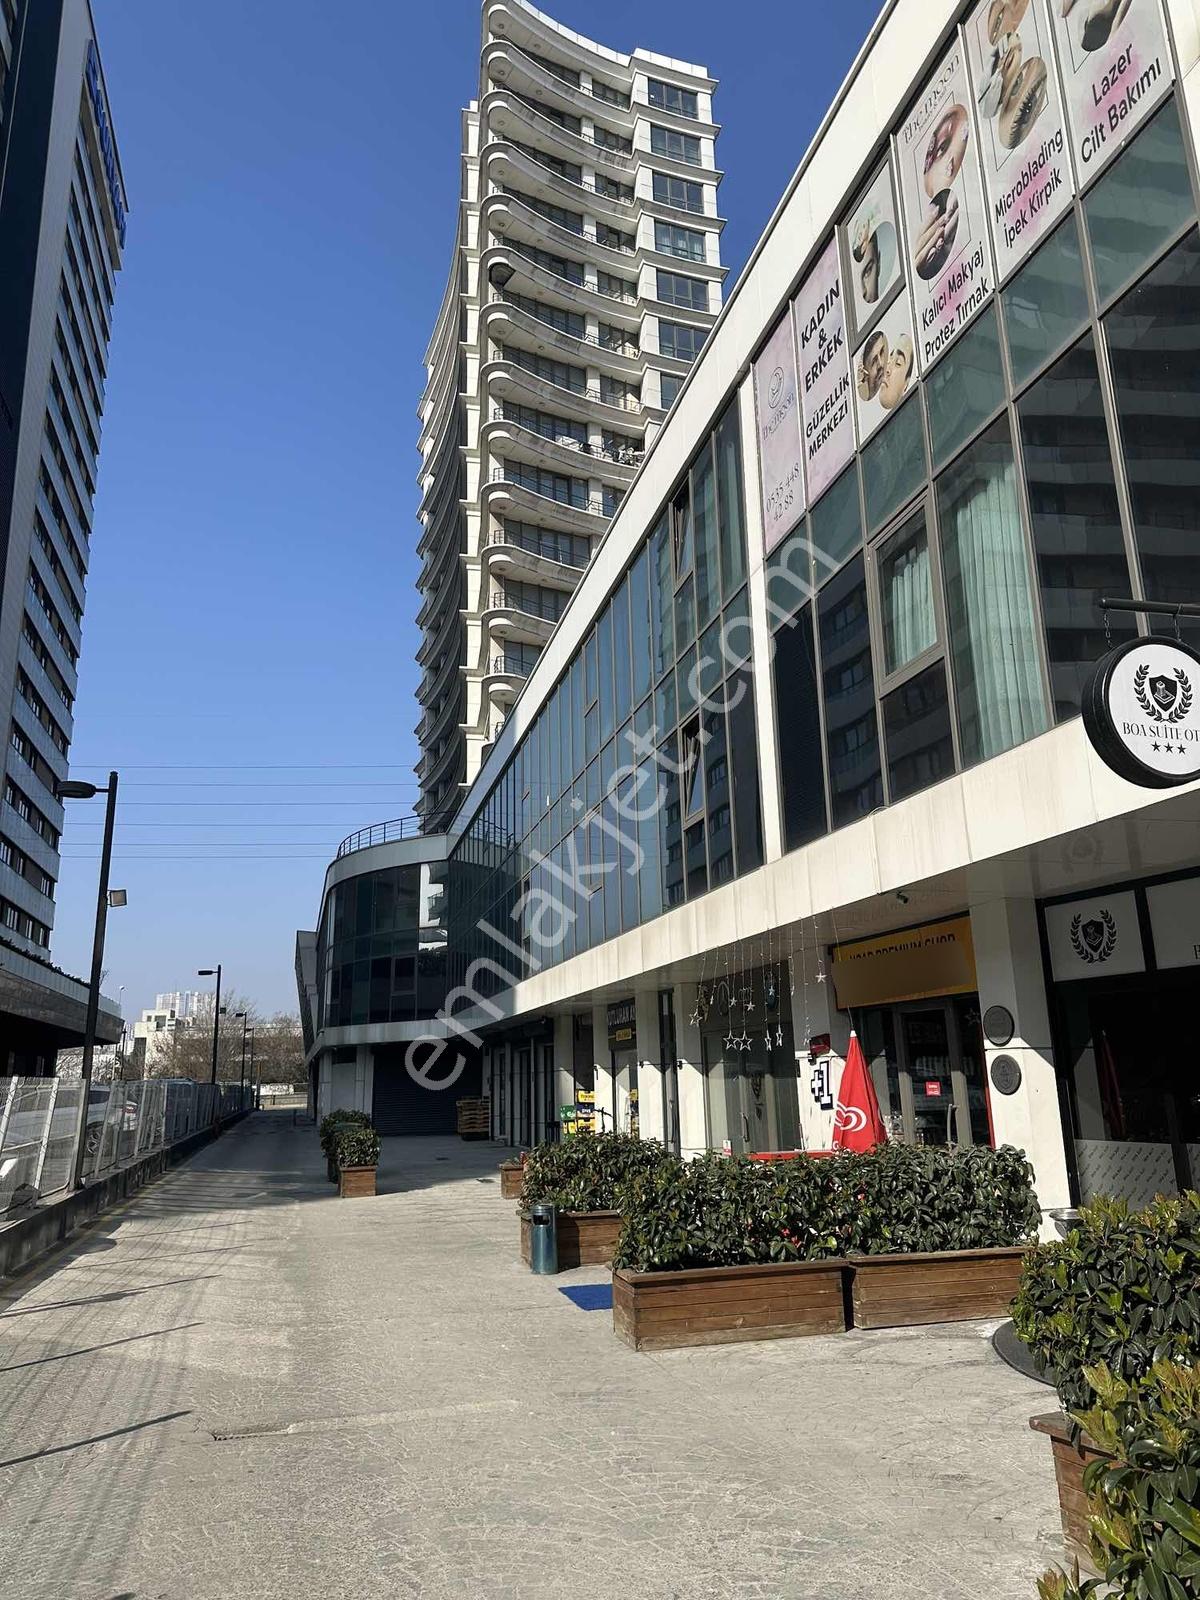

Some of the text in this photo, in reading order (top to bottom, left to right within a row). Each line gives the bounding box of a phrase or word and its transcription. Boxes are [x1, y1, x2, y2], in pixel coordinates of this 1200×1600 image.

[1091, 43, 1132, 107] Lazer
[1081, 57, 1161, 163] Cilt Bakımı
[995, 128, 1064, 224] Microblading
[1028, 167, 1062, 218] Kirpik
[801, 279, 840, 350] KADIN
[922, 240, 984, 331] Kalıcı Makyaj
[818, 327, 828, 350] &
[925, 277, 989, 363] Protez Tırnak
[805, 326, 843, 393] ERKEK
[806, 372, 850, 438] GÜZELLİK
[809, 396, 848, 460] MERKEZİ
[1123, 722, 1147, 736] BOA
